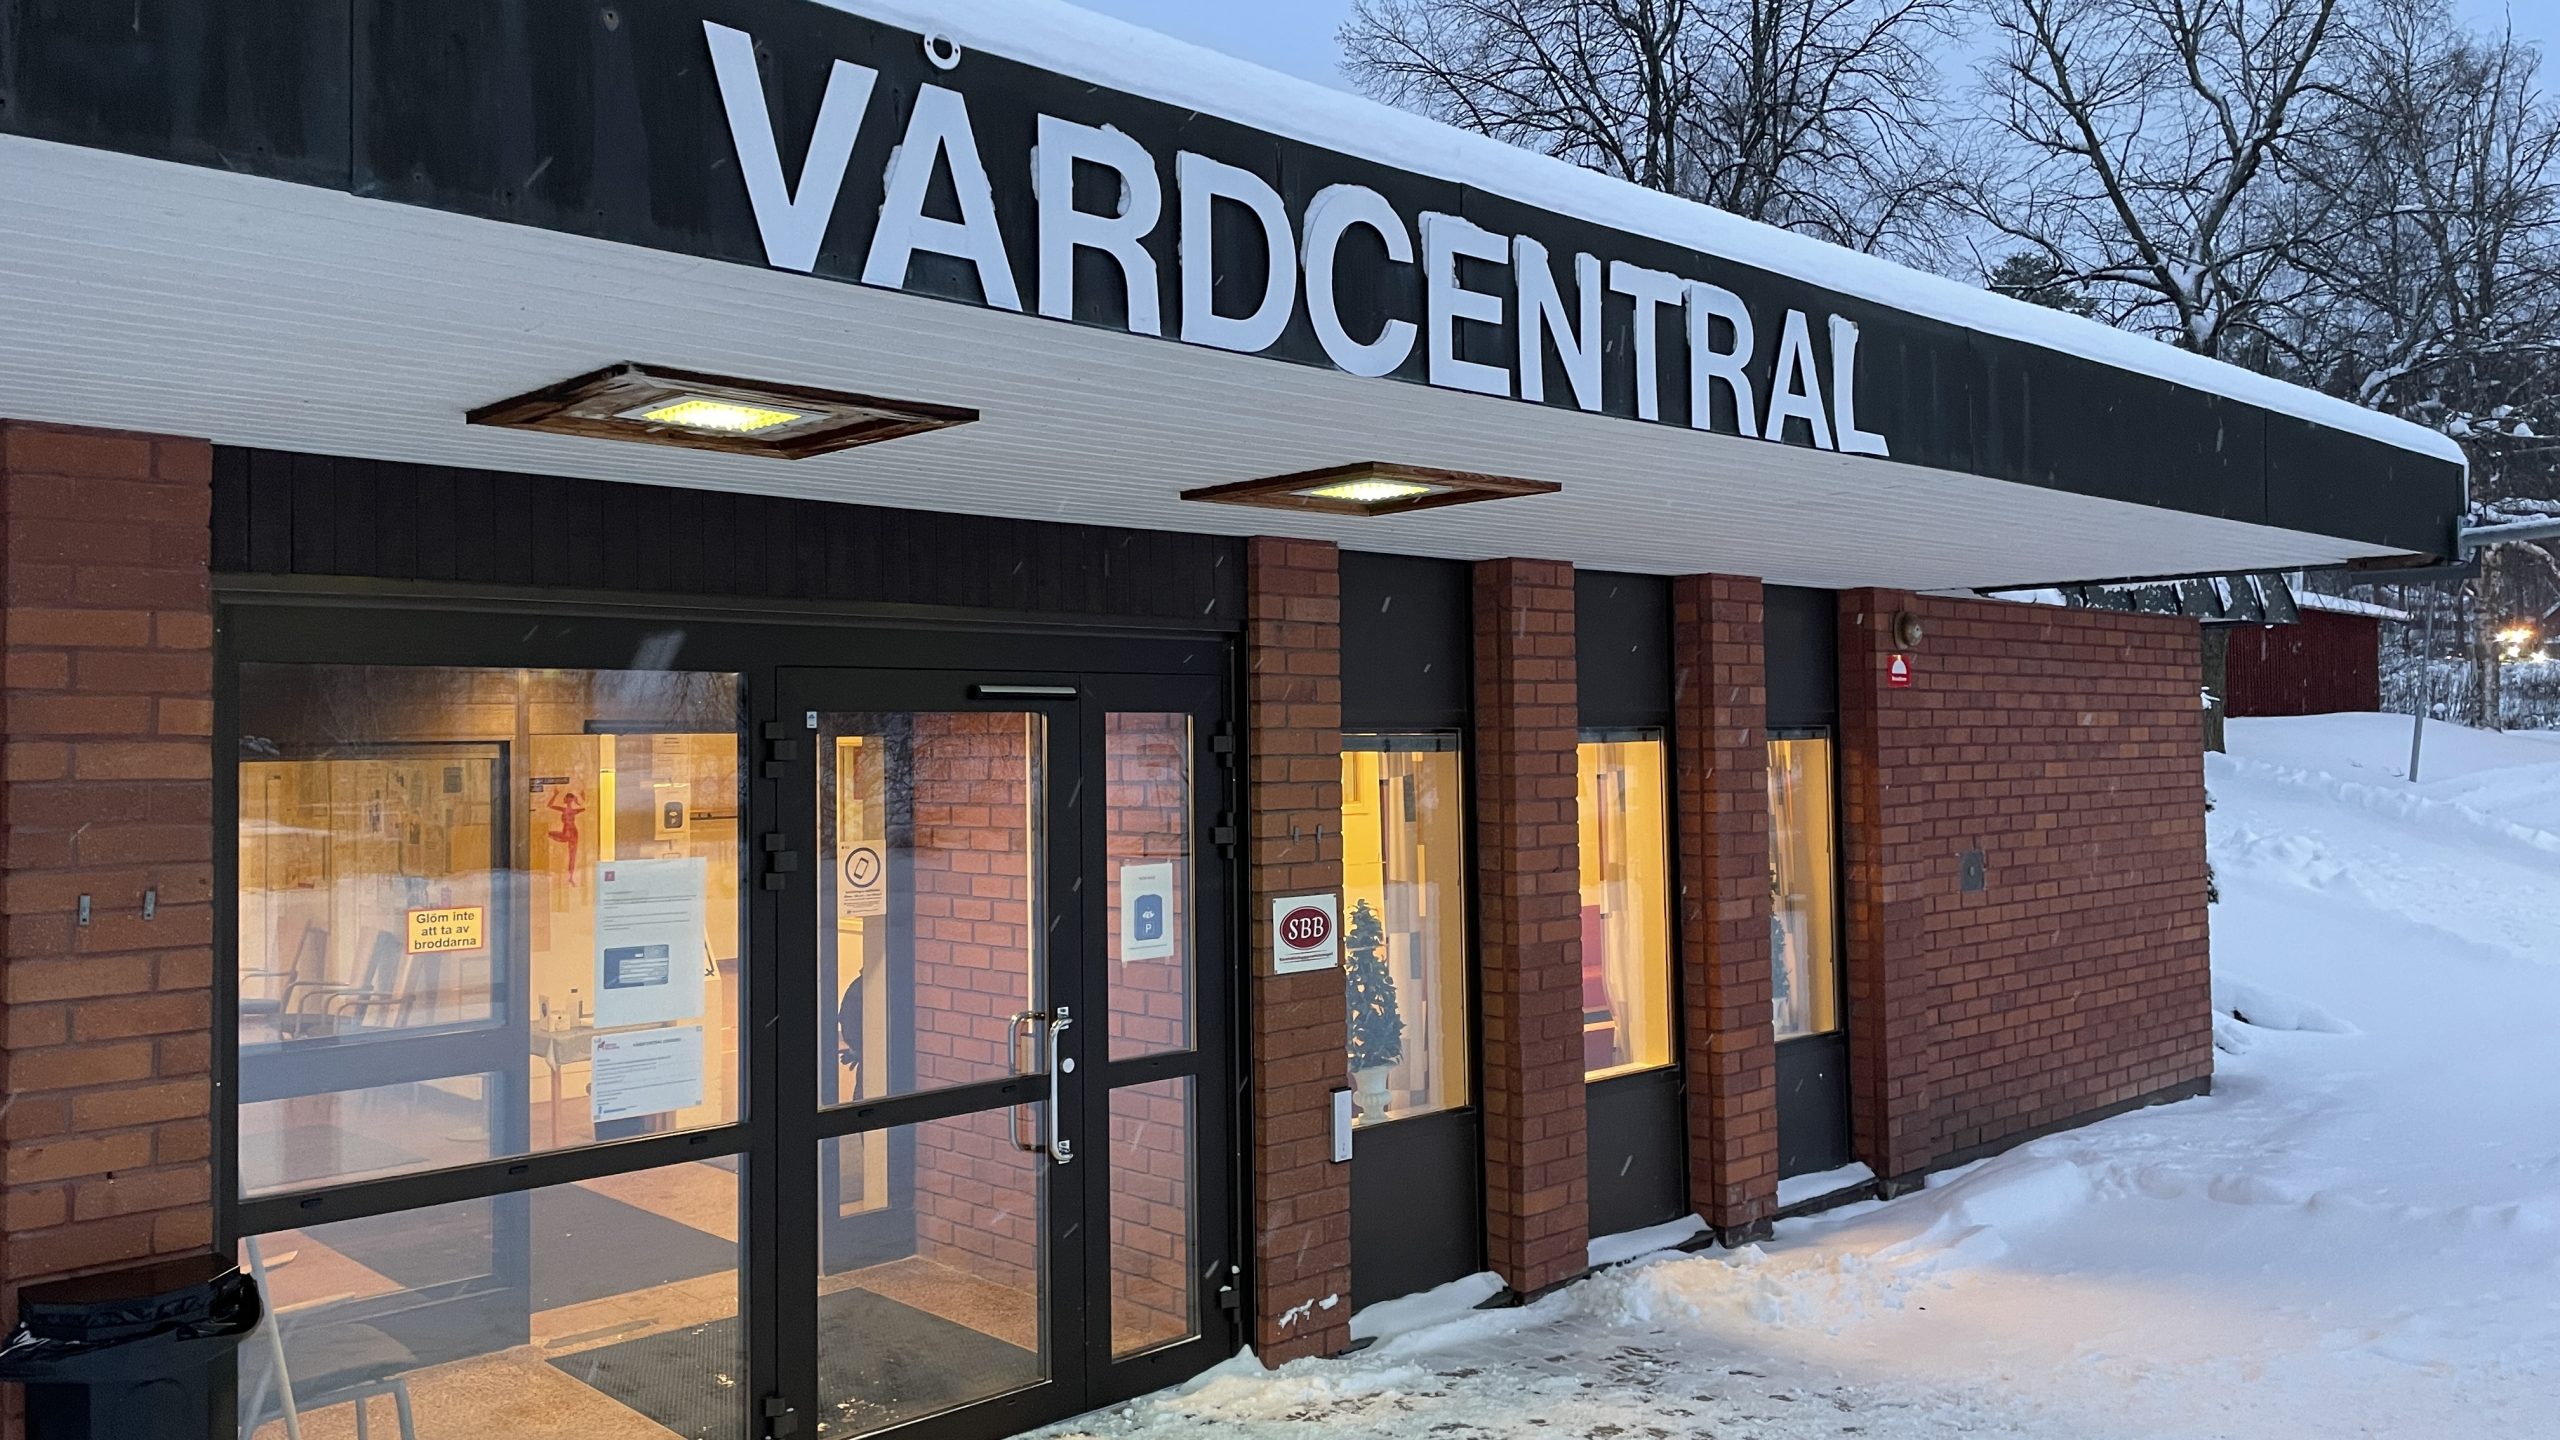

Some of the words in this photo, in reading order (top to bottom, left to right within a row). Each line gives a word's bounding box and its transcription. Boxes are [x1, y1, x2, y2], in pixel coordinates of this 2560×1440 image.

[701, 18, 1891, 457] VÅRDCENTRAL
[416, 913, 449, 923] Glöm
[453, 912, 475, 921] inte
[421, 926, 437, 936] att
[441, 926, 452, 934] ta
[456, 925, 469, 933] av
[1145, 923, 1152, 934] P
[1288, 916, 1324, 940] SBB
[414, 938, 476, 950] broddarna
